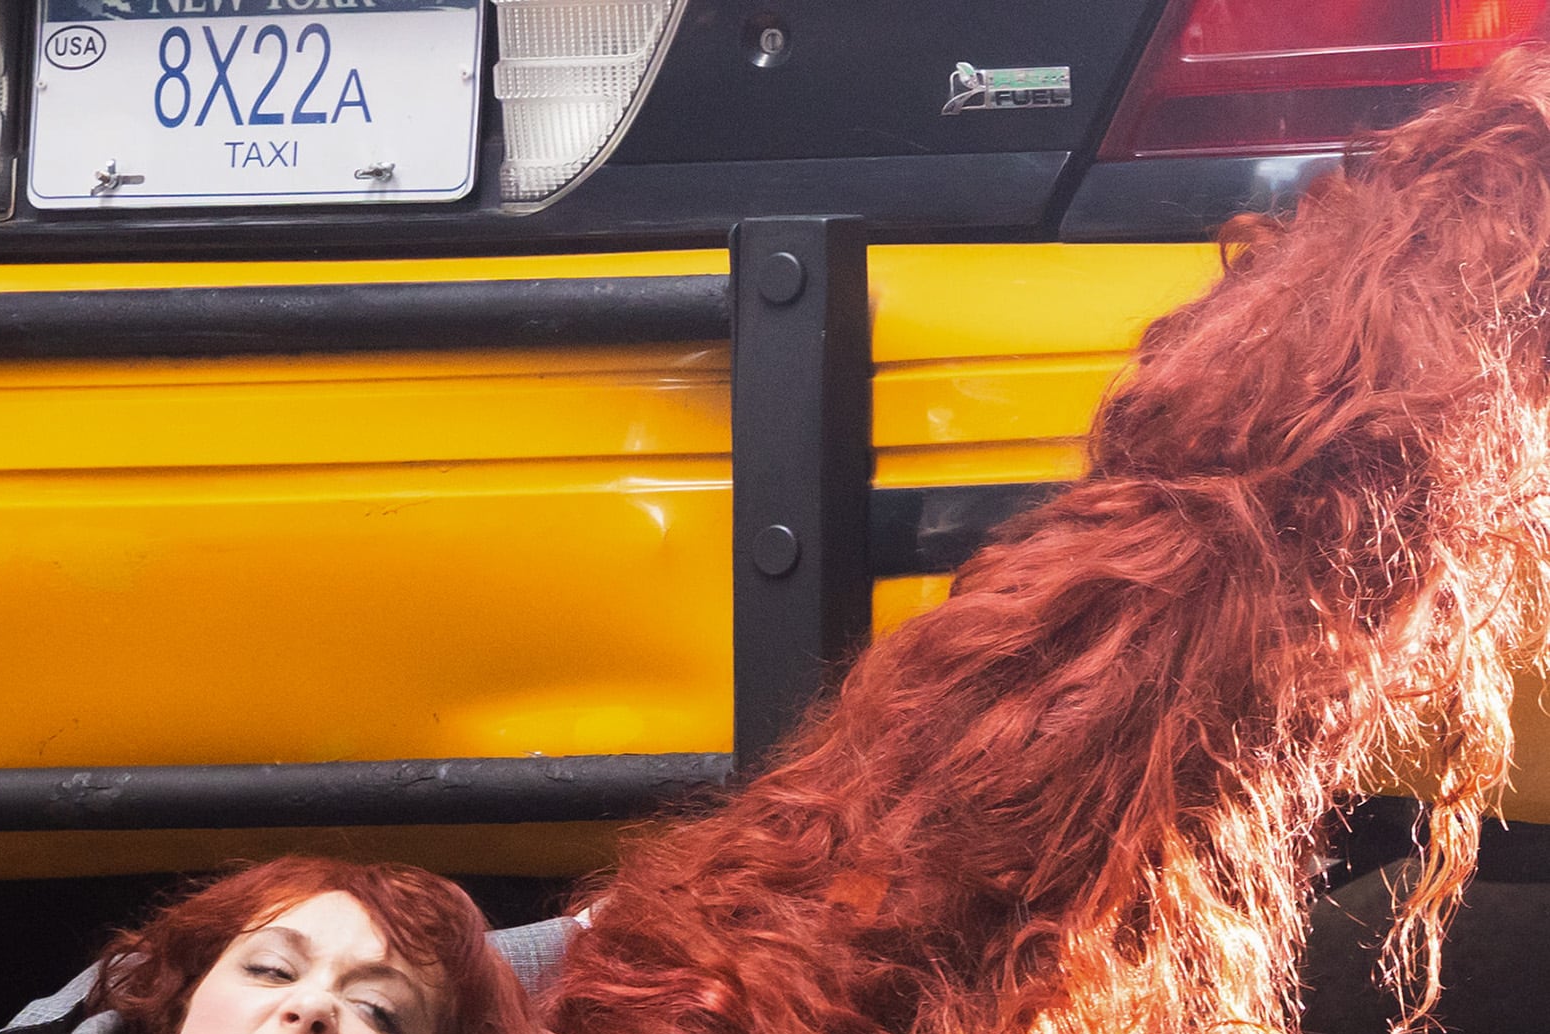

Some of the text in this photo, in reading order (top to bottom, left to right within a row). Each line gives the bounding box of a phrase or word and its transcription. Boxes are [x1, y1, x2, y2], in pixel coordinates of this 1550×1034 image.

[54, 36, 98, 57] USA
[154, 23, 372, 128] 8X22A
[995, 89, 1066, 106] FUEL
[224, 141, 298, 168] TAXI
